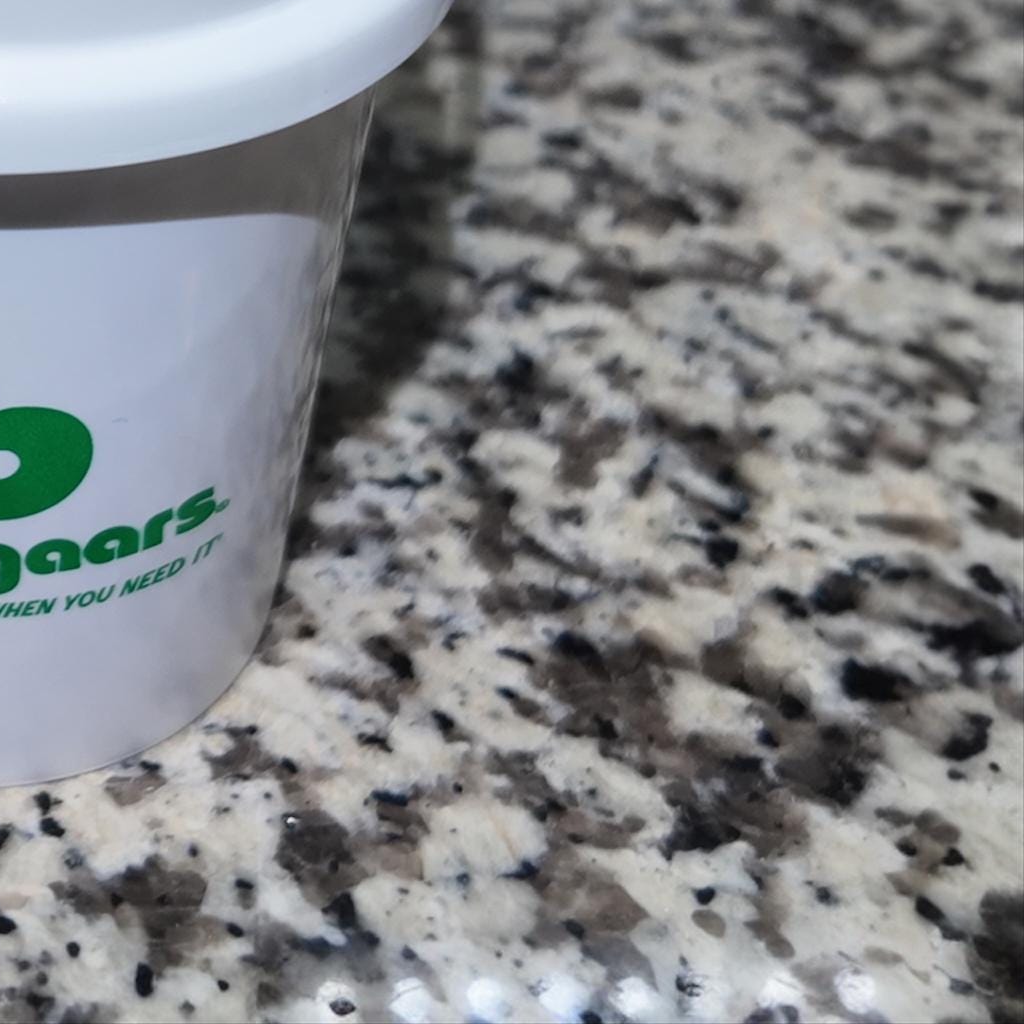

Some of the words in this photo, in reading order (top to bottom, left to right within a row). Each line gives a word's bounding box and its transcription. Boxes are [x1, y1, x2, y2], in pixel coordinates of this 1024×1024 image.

[63, 584, 116, 612] YOU
[119, 557, 186, 598] NEED
[191, 533, 219, 566] IT
